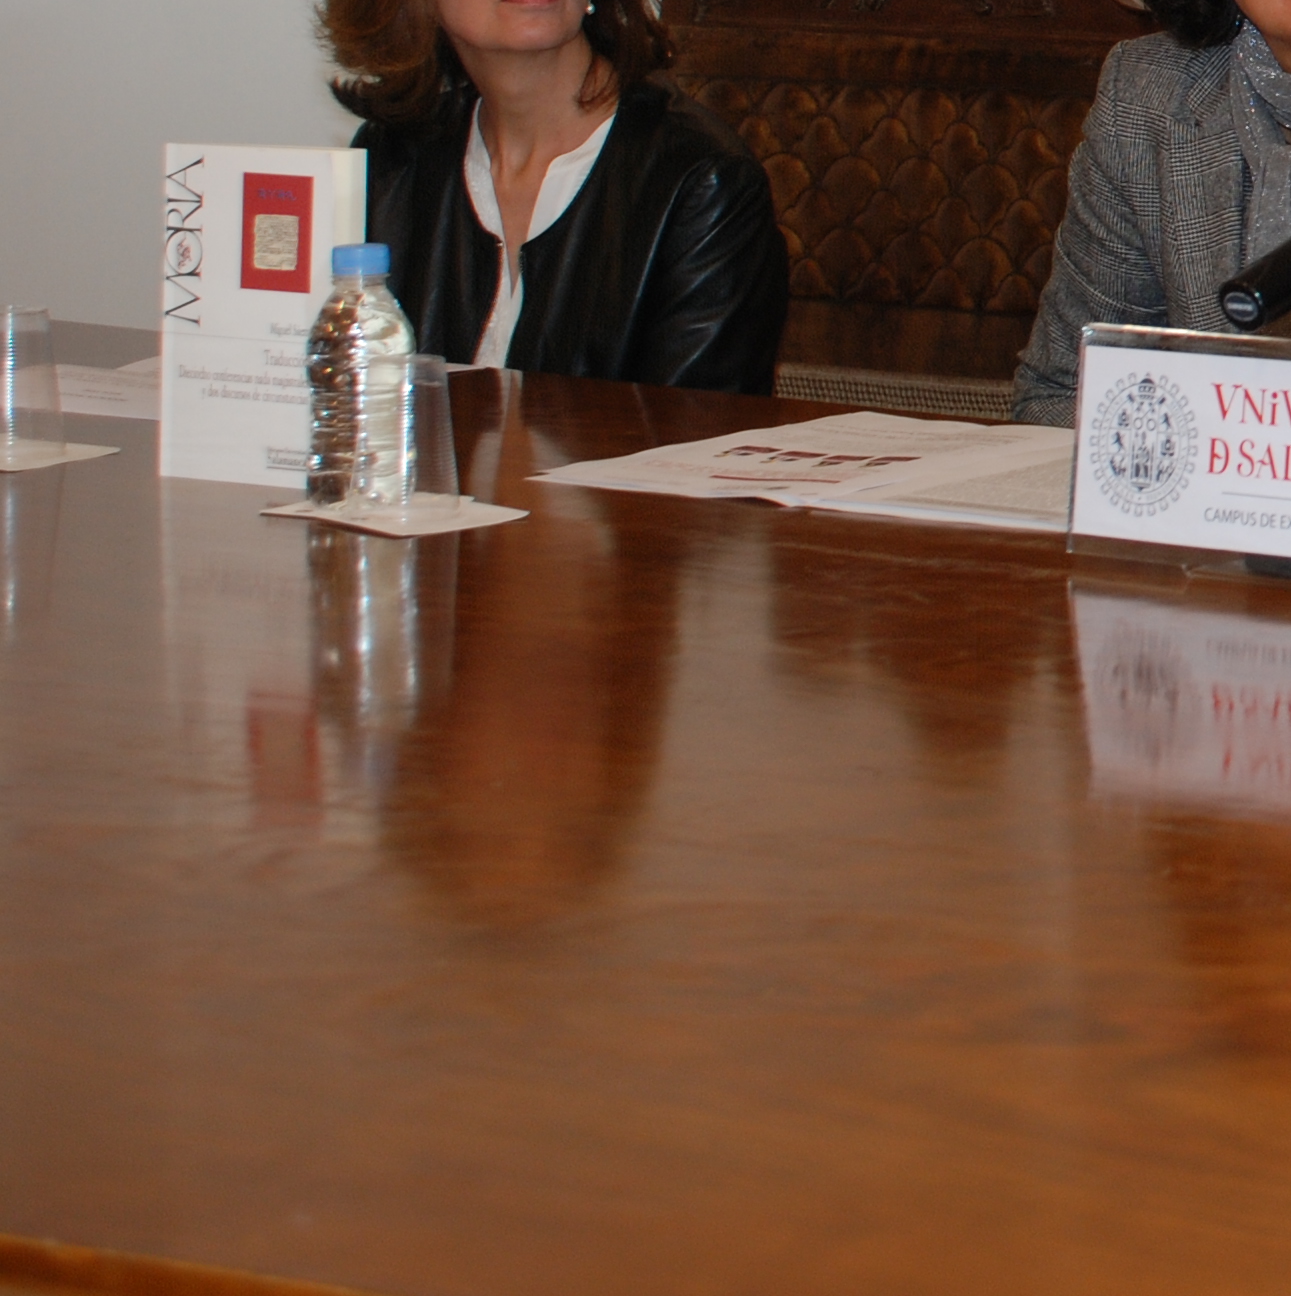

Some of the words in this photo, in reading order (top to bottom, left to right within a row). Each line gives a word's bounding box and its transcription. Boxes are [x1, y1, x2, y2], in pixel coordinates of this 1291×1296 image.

[264, 348, 306, 368] Traducció
[1204, 507, 1257, 527] CAMPUS
[1260, 512, 1278, 529] DE
